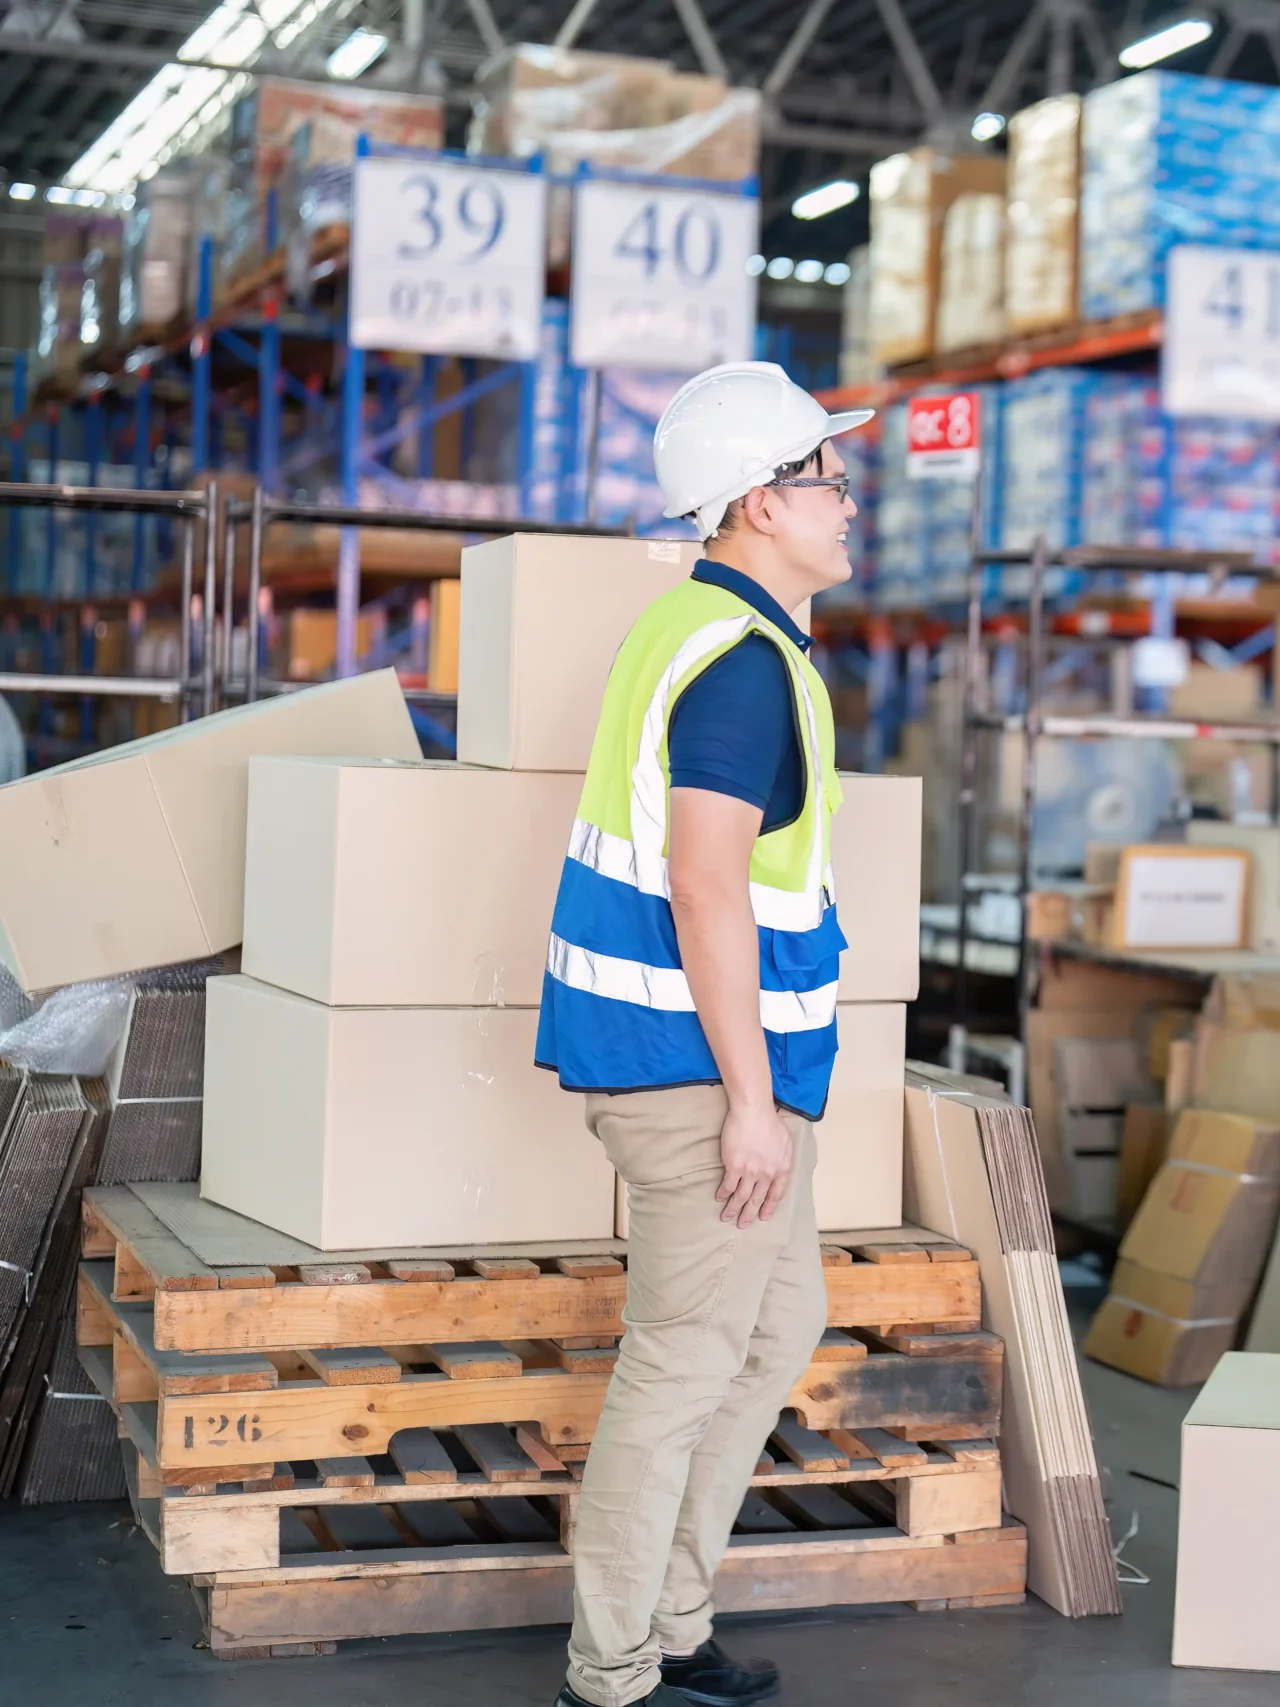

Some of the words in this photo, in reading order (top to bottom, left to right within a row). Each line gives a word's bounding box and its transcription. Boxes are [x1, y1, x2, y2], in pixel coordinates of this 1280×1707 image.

[397, 172, 508, 266] 39
[612, 196, 723, 288] 40
[947, 395, 972, 447] 8
[184, 1414, 262, 1449] 126
